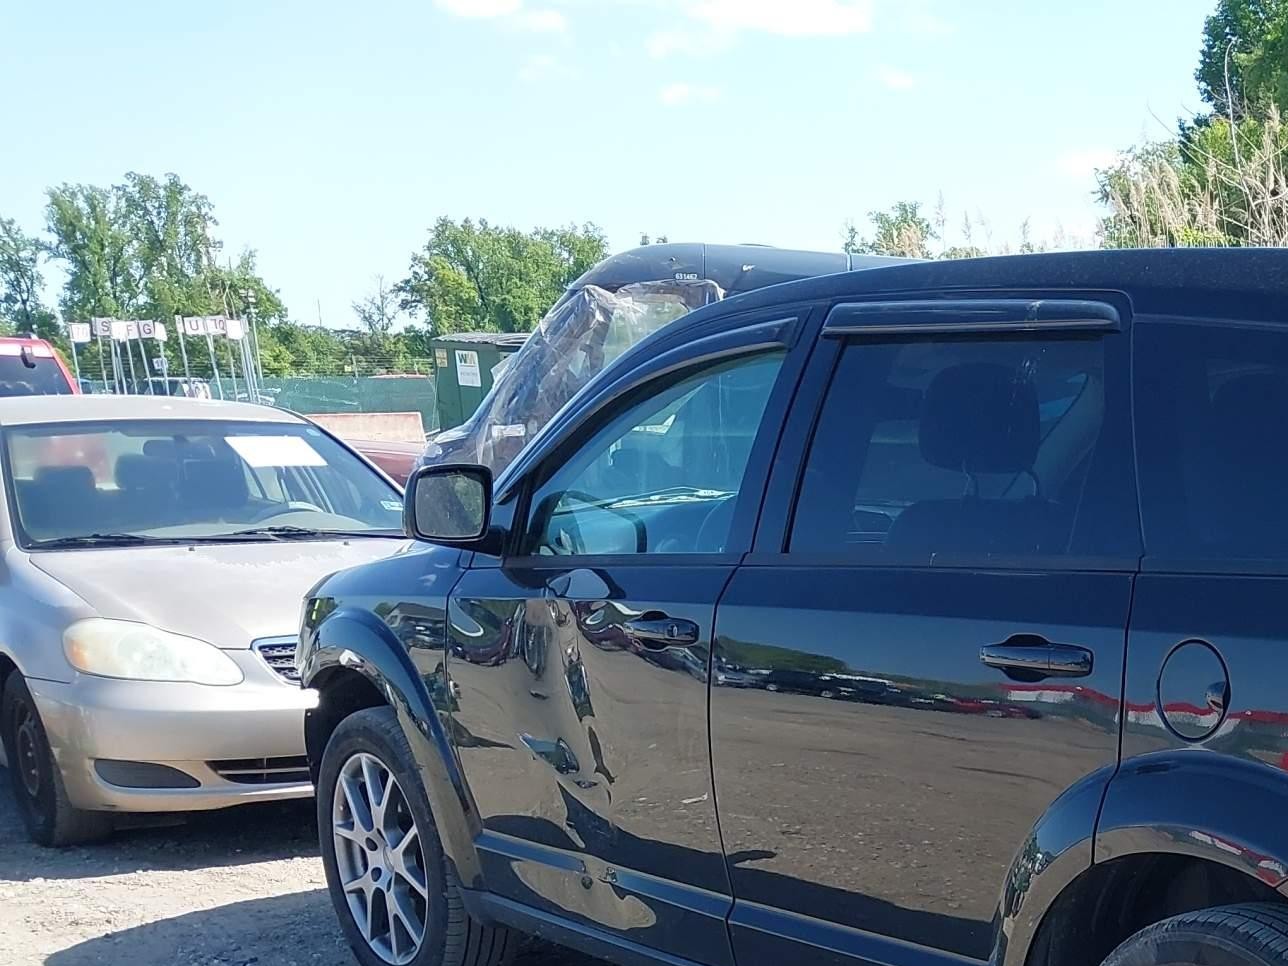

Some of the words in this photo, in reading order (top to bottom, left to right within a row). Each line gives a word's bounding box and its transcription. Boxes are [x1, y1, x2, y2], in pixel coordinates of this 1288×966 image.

[101, 321, 110, 332] S
[143, 323, 152, 335] G
[189, 319, 199, 331] U
